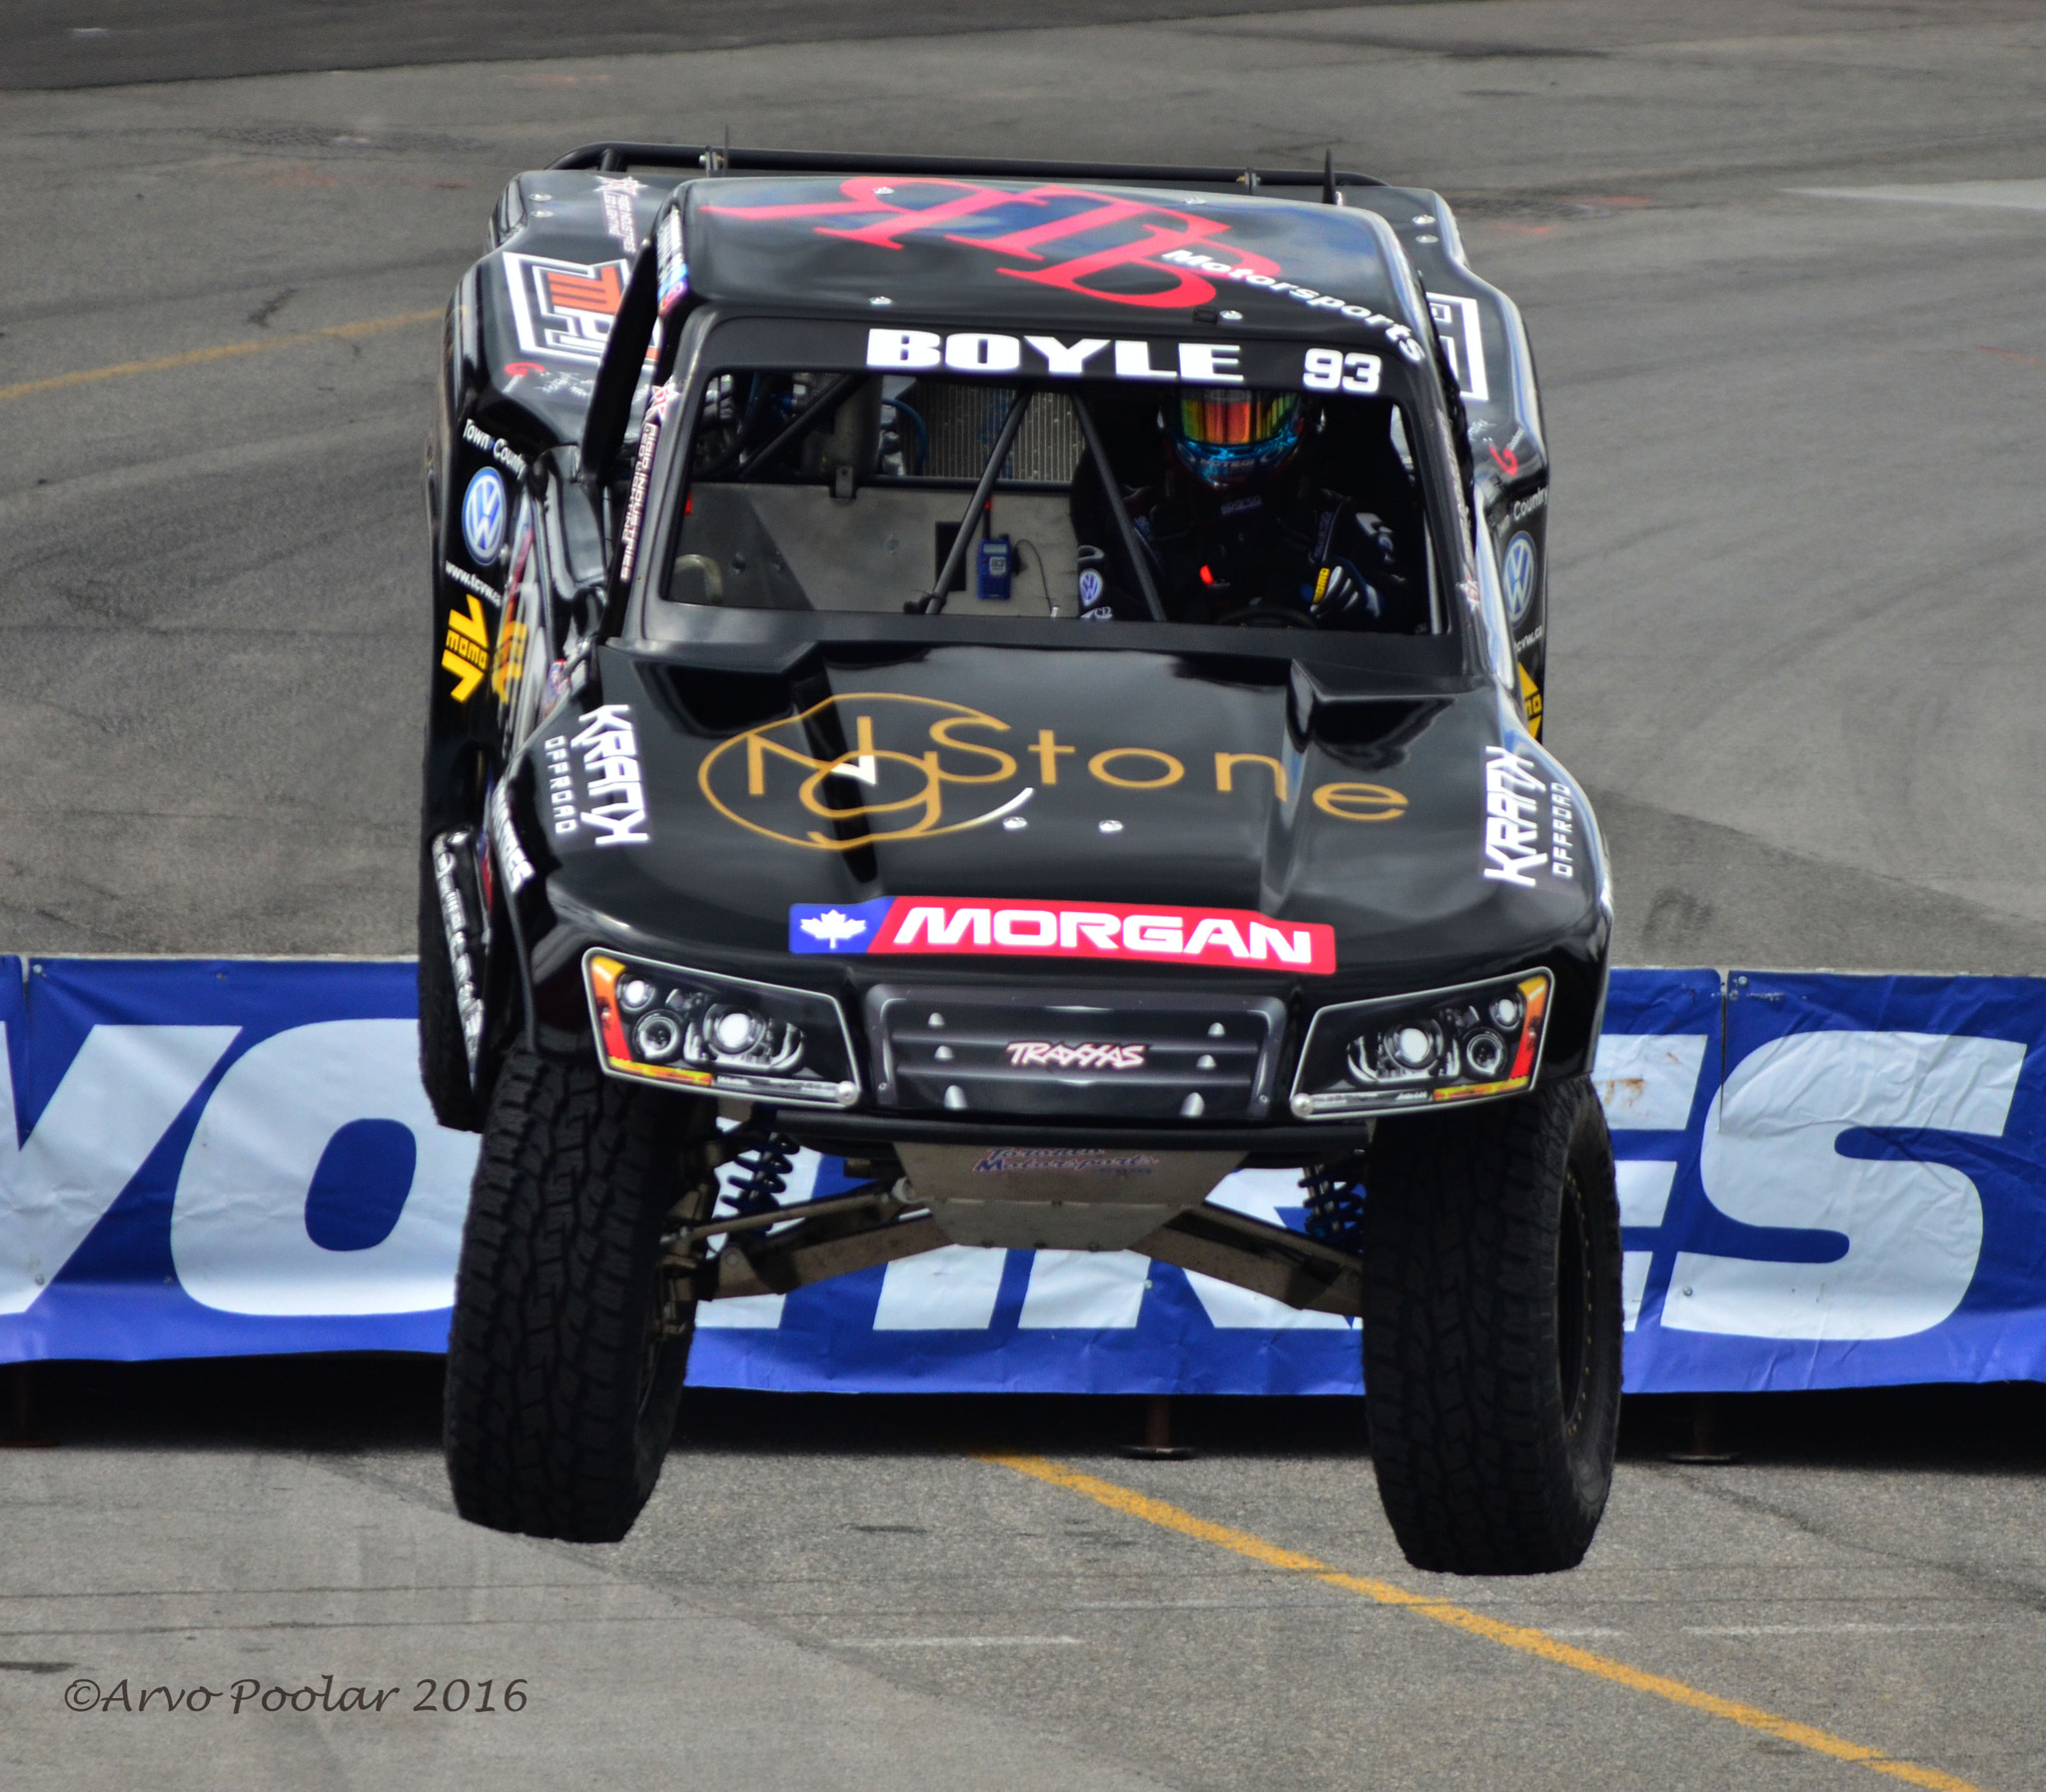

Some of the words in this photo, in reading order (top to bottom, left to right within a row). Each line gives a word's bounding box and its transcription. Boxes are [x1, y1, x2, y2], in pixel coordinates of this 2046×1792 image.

[1162, 249, 1426, 363] Motorsports
[866, 329, 1244, 384] BOYLE
[1303, 347, 1383, 395] 93
[464, 419, 490, 454] Town
[544, 734, 579, 835] OFFROAD
[571, 703, 650, 845] KRANK
[1484, 745, 1548, 888] KRANK
[1550, 781, 1574, 879] OFFROAD
[893, 906, 1313, 966] MORGAN
[1005, 1040, 1147, 1070] TRAXXAS
[971, 1154, 1161, 1174] Motorsports
